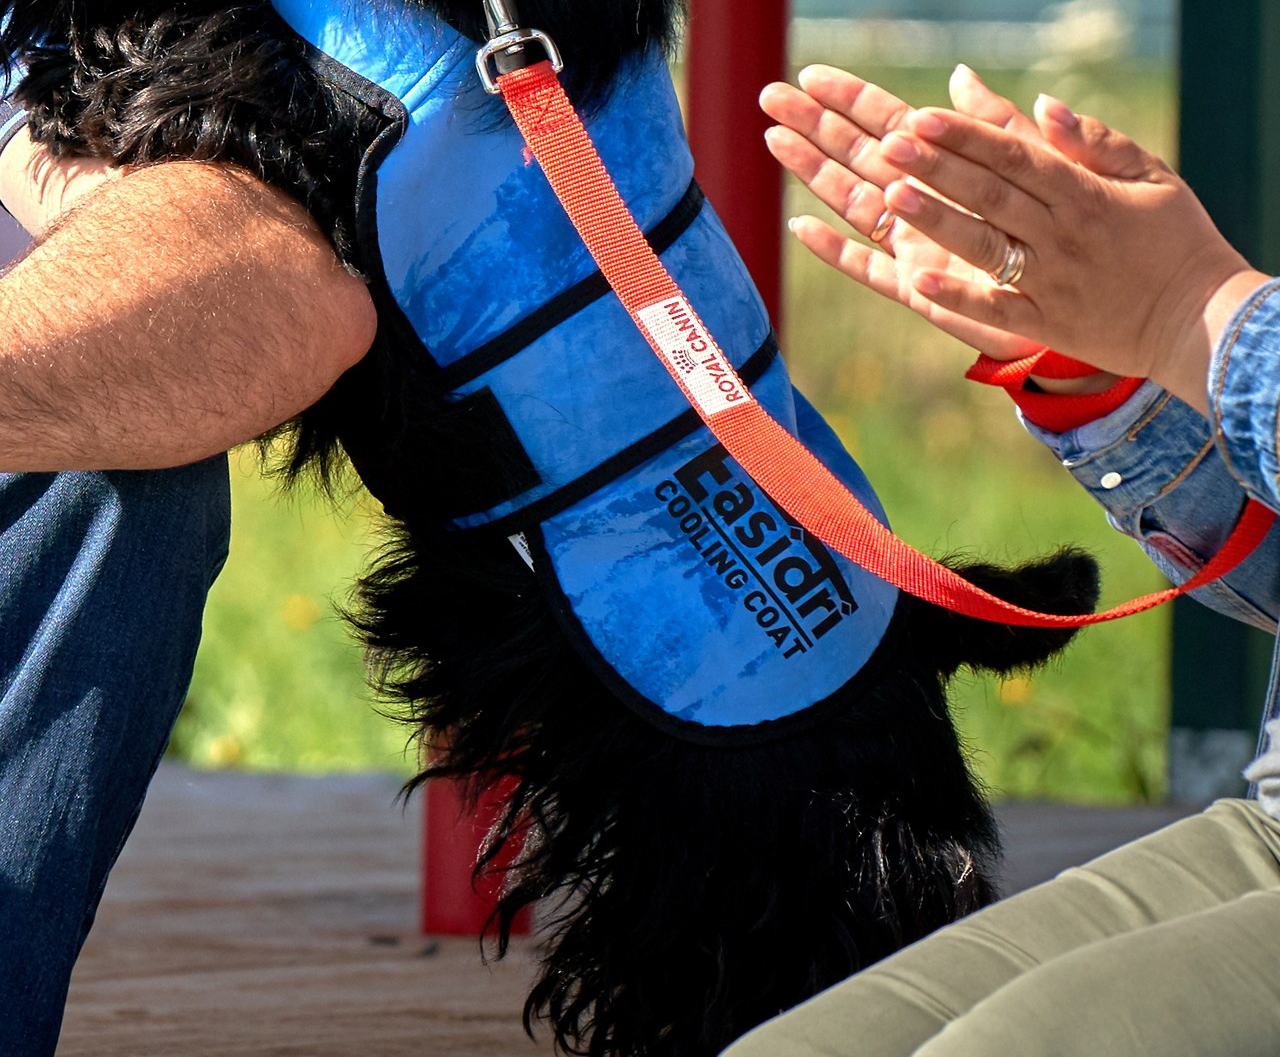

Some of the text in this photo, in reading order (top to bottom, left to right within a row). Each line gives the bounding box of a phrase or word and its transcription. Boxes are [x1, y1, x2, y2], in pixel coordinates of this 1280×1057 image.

[664, 301, 744, 402] ROYAL CANIN
[654, 480, 807, 659] COOLING COAT
[674, 444, 859, 640] Easidri
